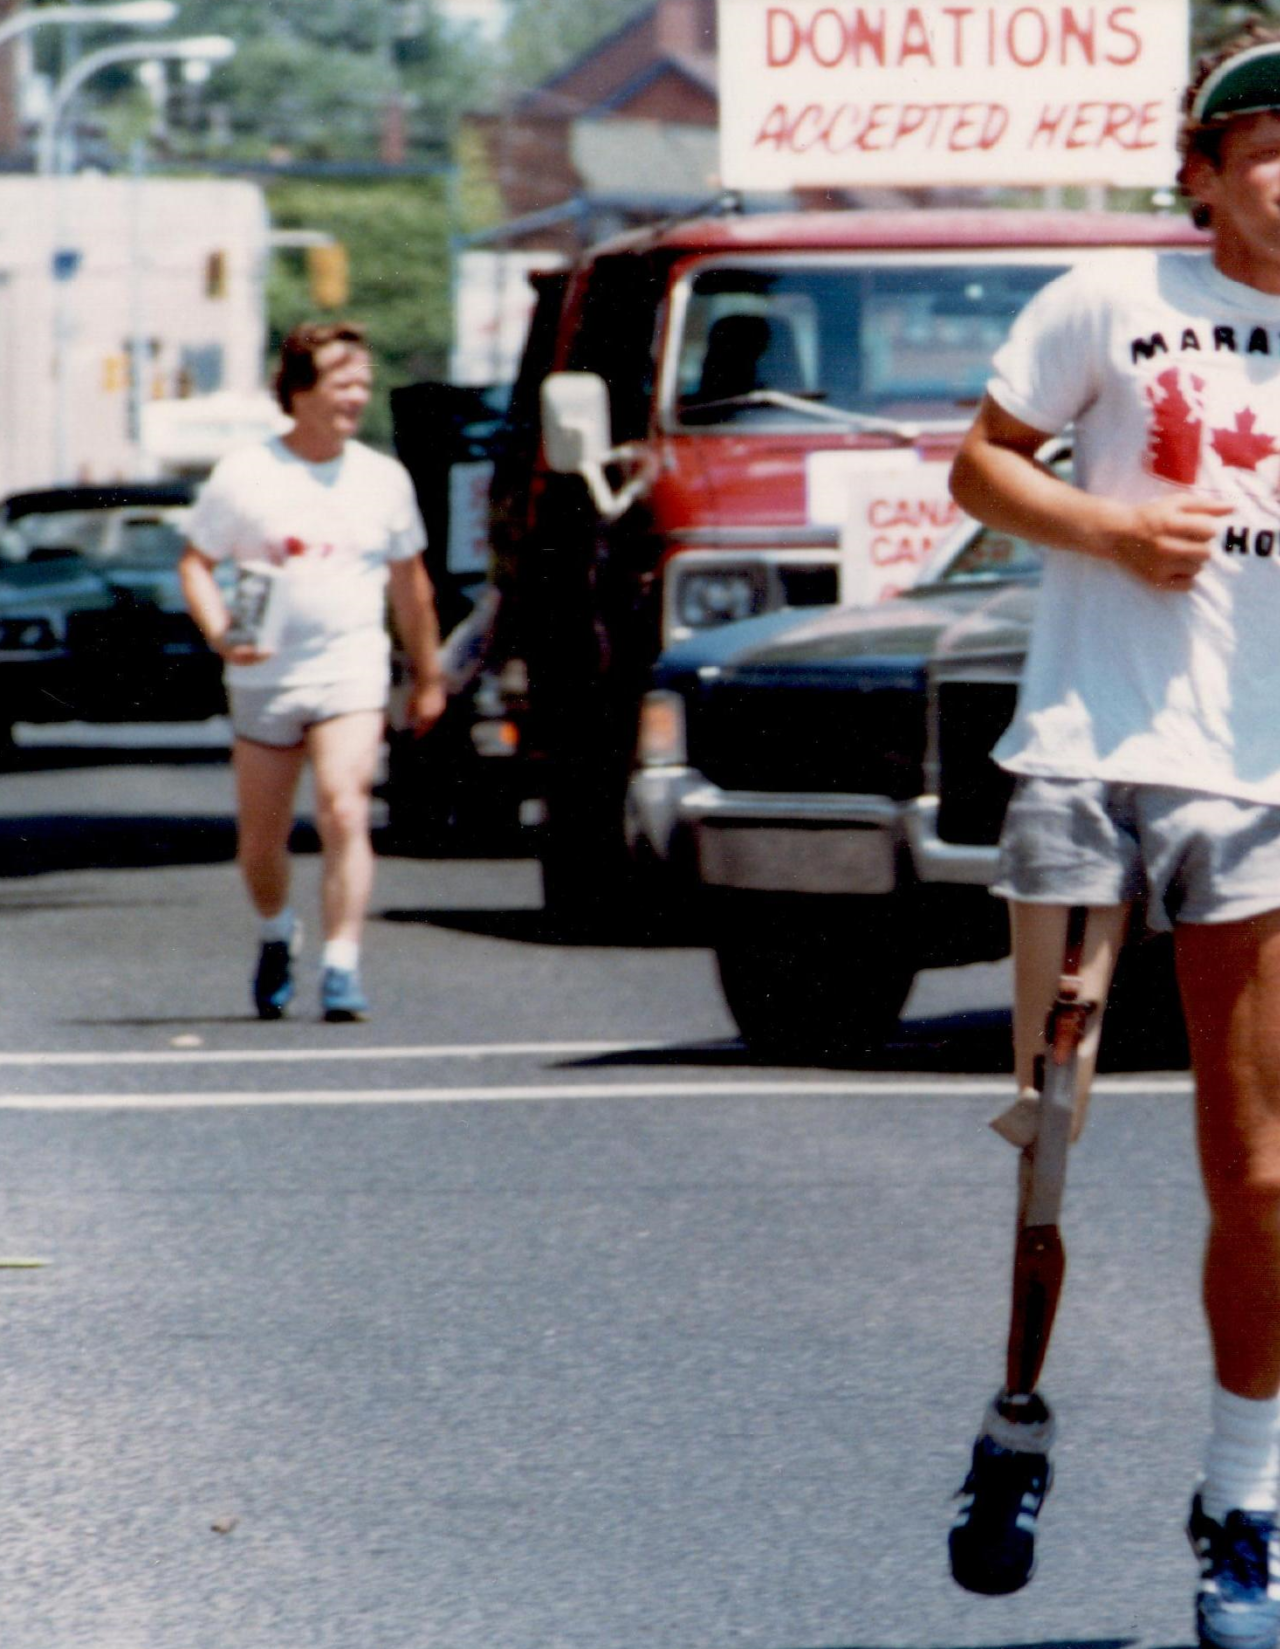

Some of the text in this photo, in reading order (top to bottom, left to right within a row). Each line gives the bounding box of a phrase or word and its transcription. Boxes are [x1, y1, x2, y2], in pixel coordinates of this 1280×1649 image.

[765, 6, 1142, 68] DONATIONS
[754, 99, 1163, 153] ACCEPTED HERE
